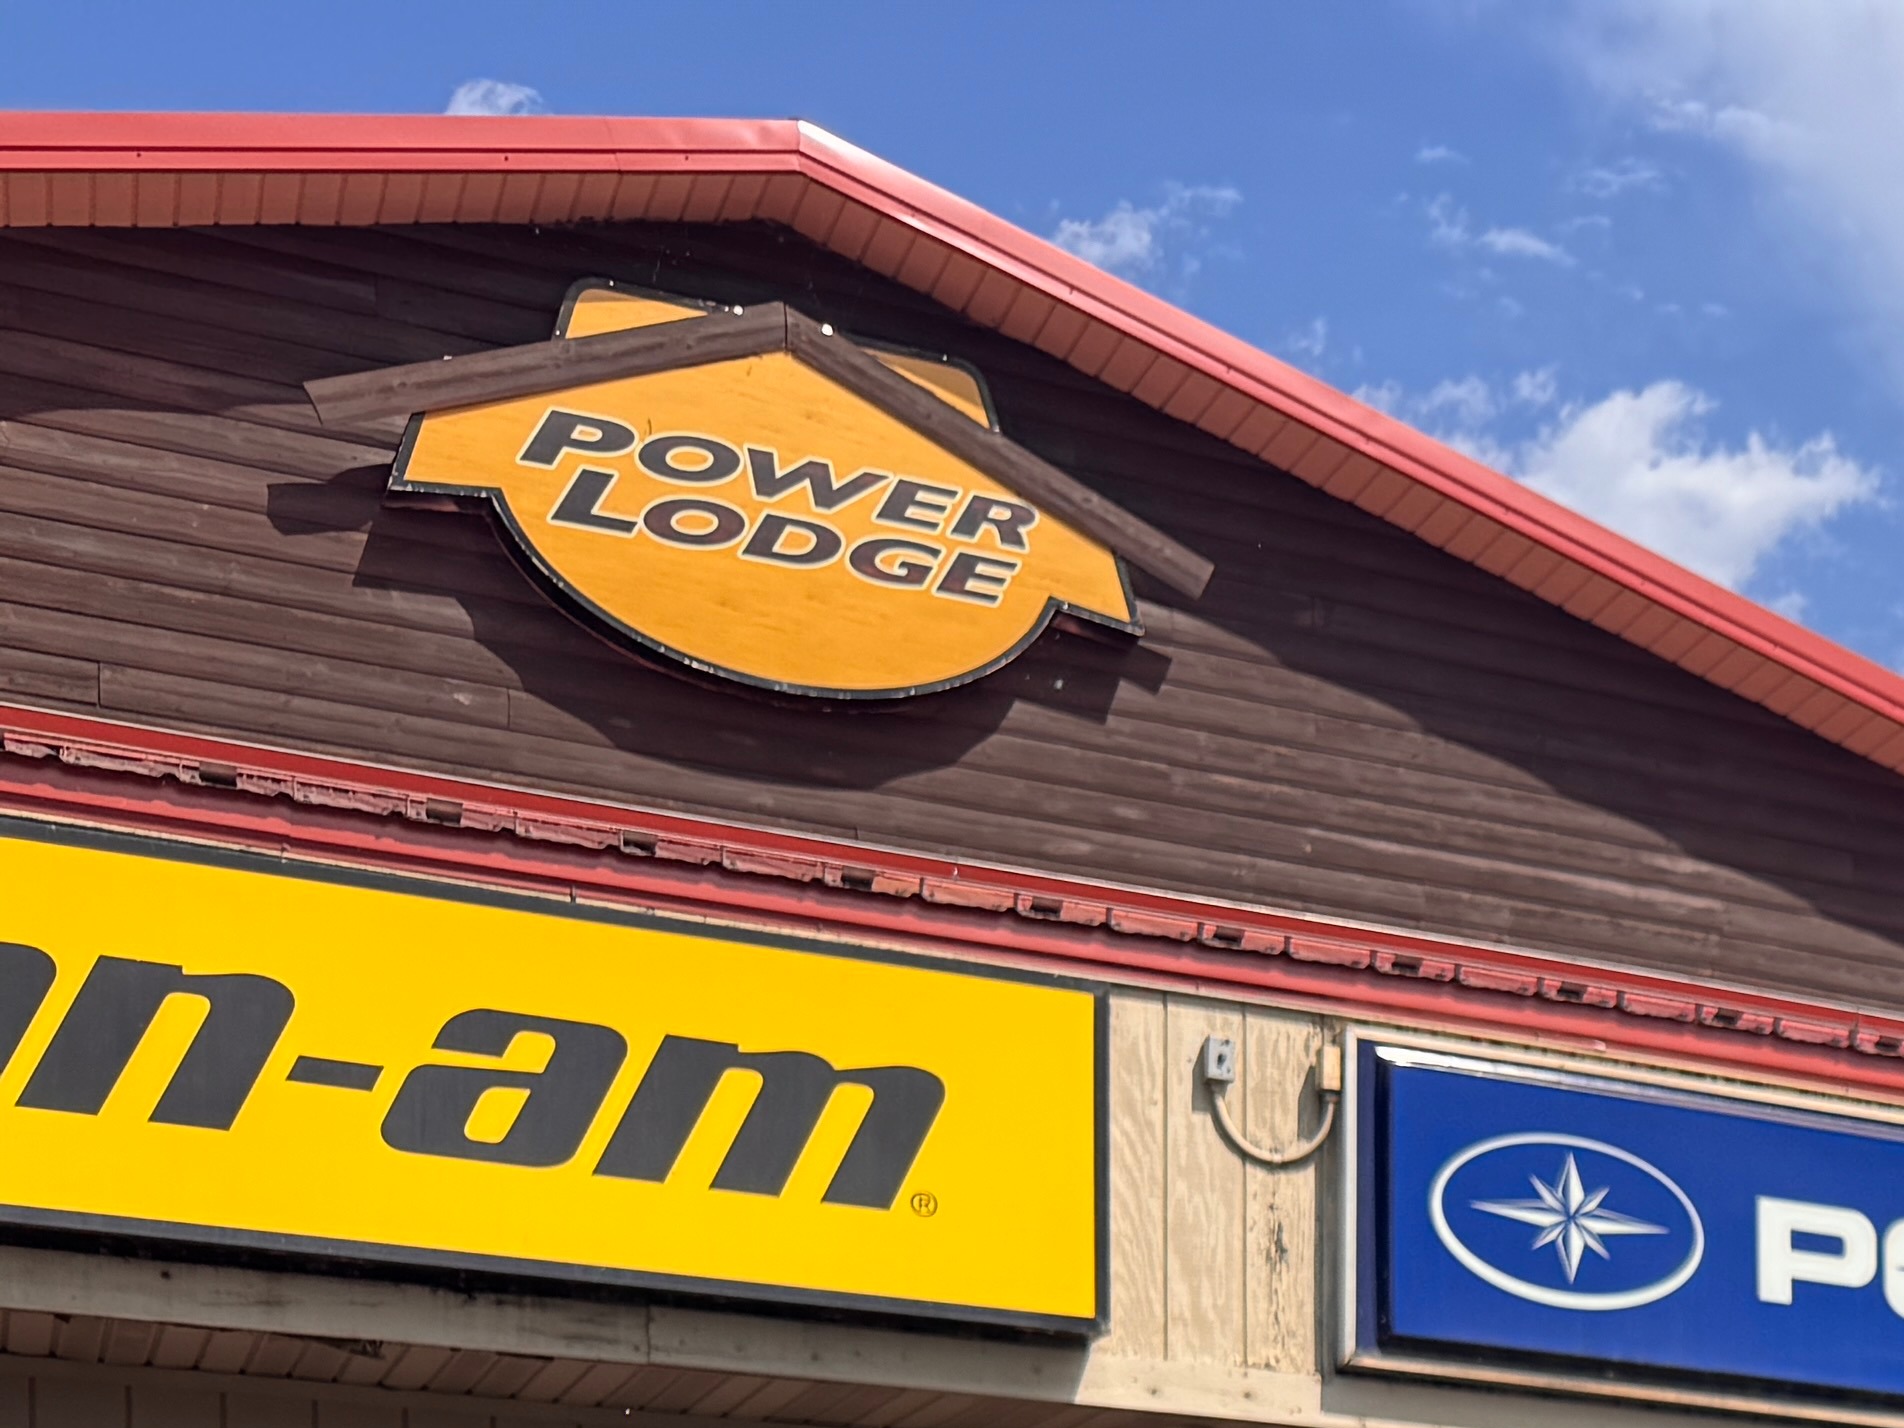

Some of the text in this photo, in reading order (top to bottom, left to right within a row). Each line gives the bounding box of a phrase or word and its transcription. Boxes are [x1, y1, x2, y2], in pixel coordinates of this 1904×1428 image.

[516, 407, 1040, 553] POWER
[547, 466, 1022, 608] LODGE
[0, 942, 946, 1211] n-am
